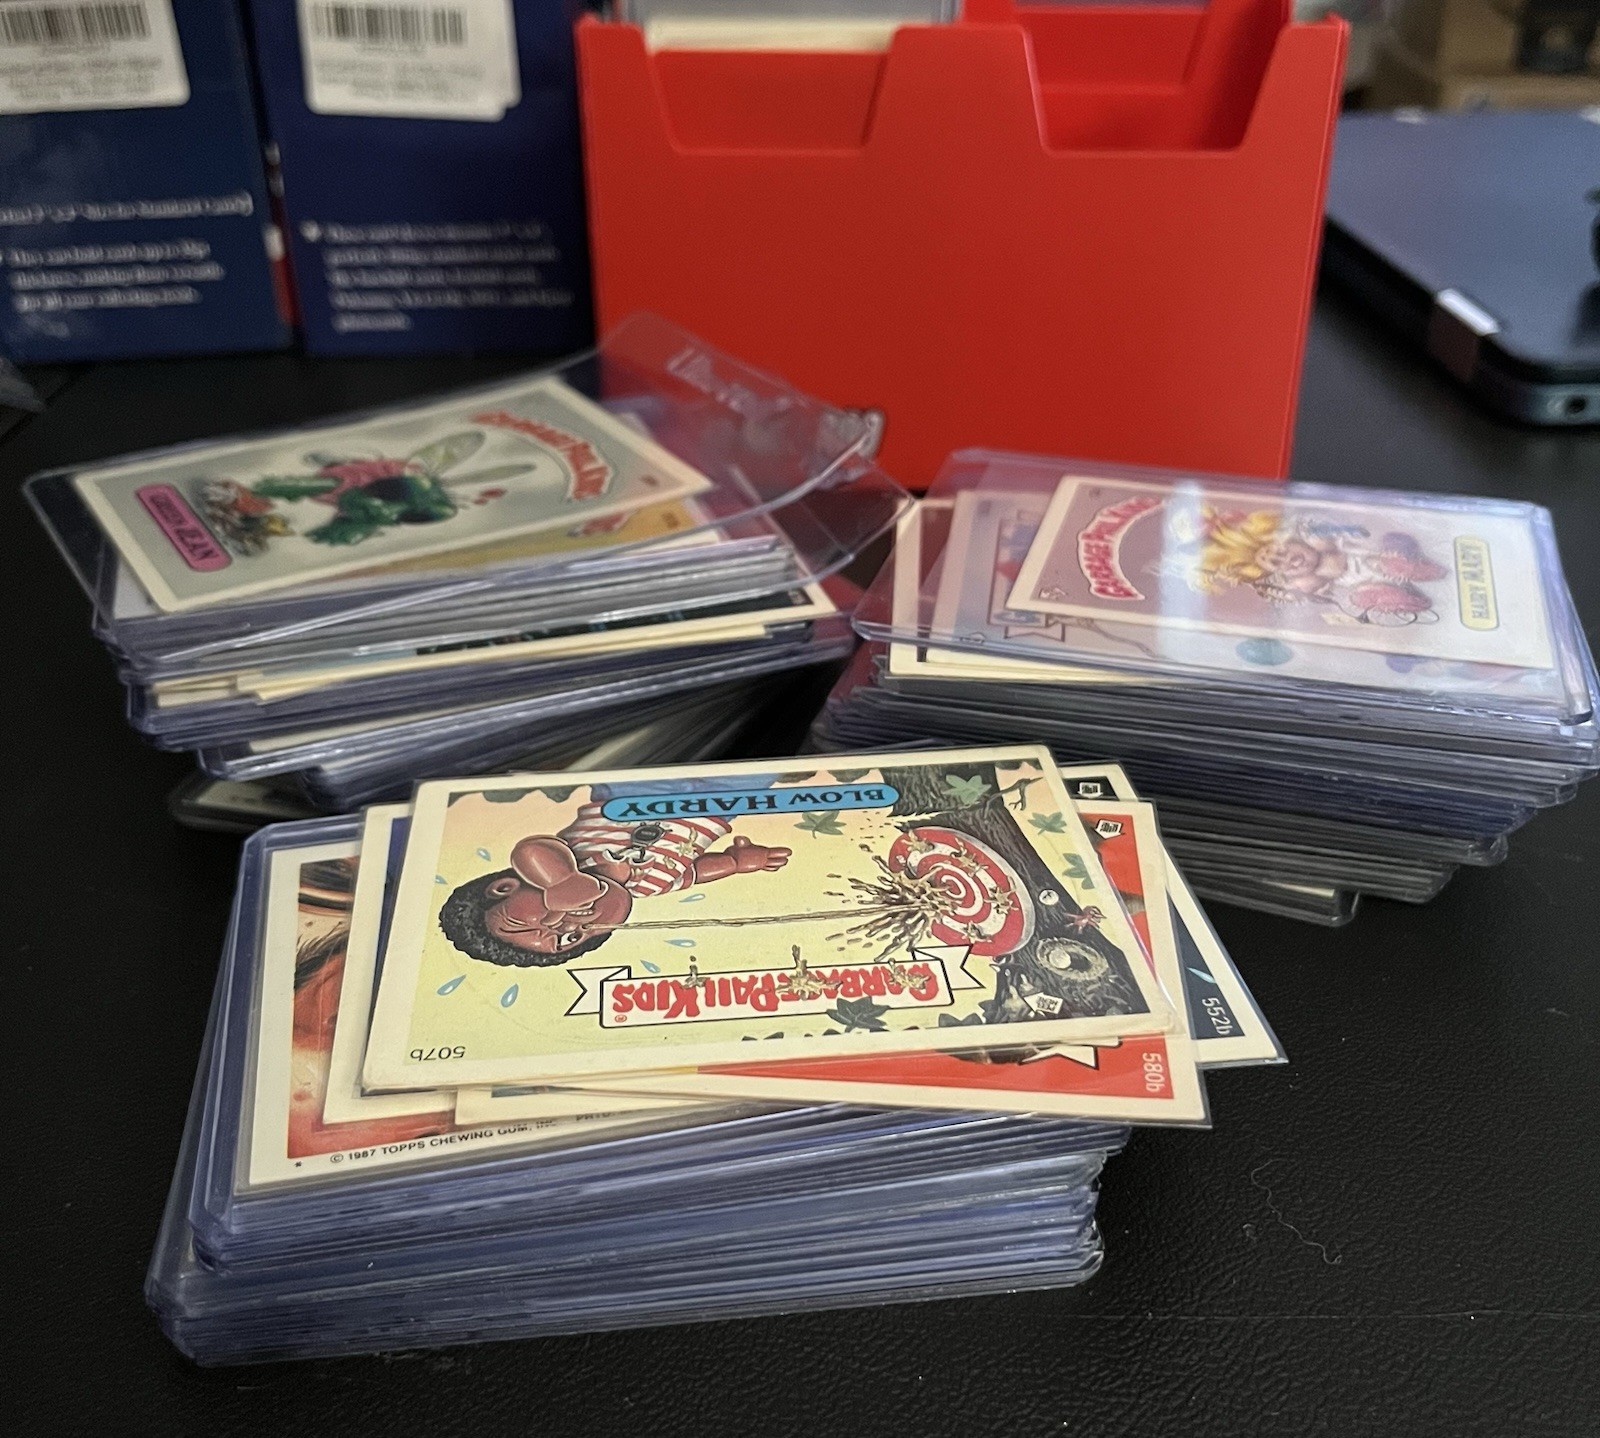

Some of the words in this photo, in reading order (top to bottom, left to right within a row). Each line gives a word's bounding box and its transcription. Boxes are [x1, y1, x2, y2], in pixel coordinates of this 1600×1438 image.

[617, 794, 778, 817] HARDY
[787, 788, 885, 805] BLOW
[1201, 996, 1232, 1036] 552b
[409, 1044, 467, 1062] 507b
[1140, 1051, 1163, 1093] 580b
[348, 1148, 377, 1161] 1987
[381, 1140, 426, 1155] TOPPS
[429, 1128, 494, 1147] CHEWING
